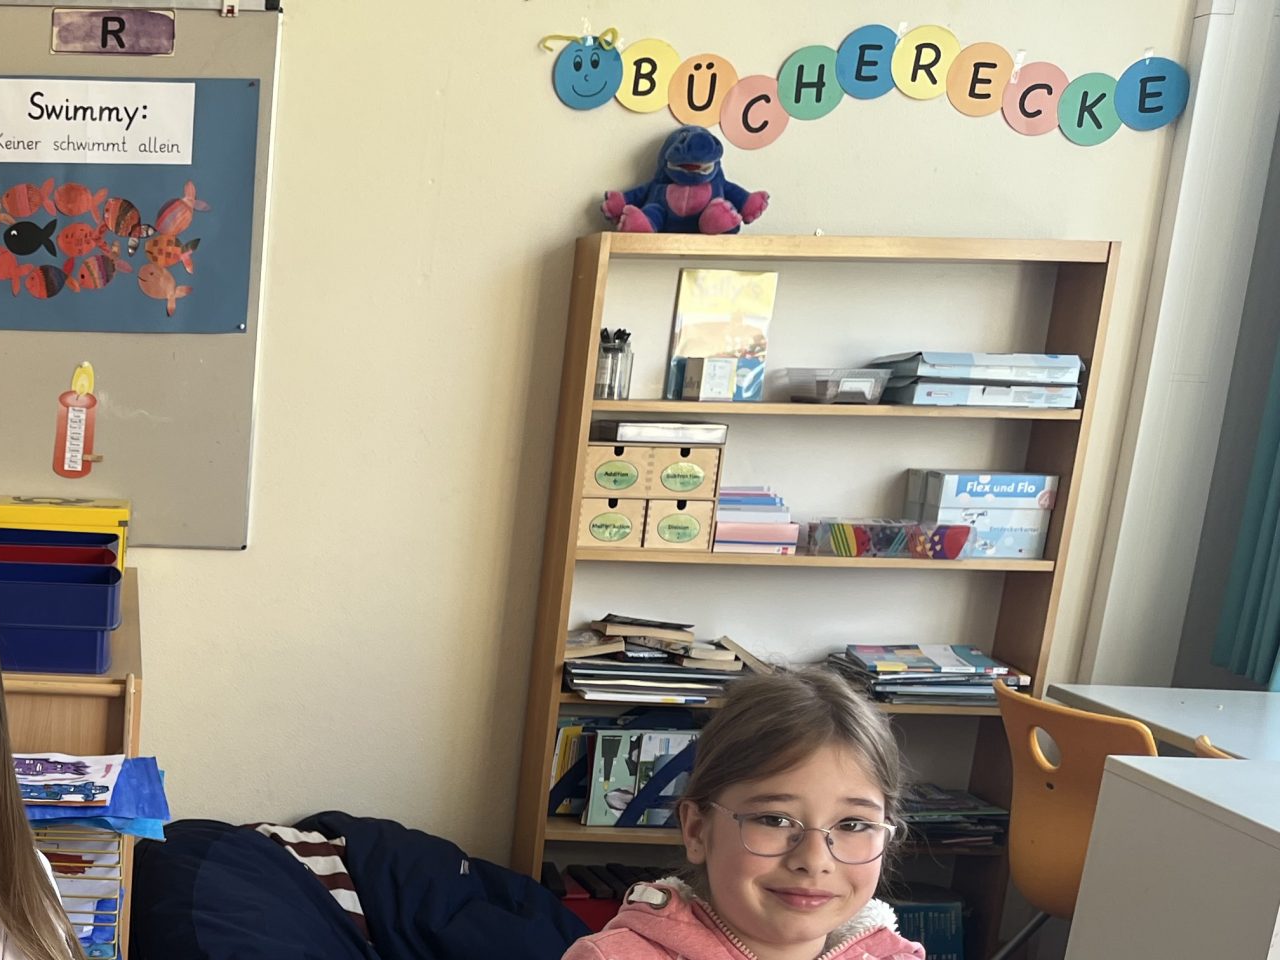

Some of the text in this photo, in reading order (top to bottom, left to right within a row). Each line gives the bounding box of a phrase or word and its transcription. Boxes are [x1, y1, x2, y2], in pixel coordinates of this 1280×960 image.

[101, 16, 126, 49] R
[632, 42, 1167, 133] BÜCHERECKE
[28, 91, 148, 130] Swimmy:
[53, 134, 128, 153] schwimmt
[138, 136, 181, 154] allein
[966, 481, 1036, 493] Flex und Flo
